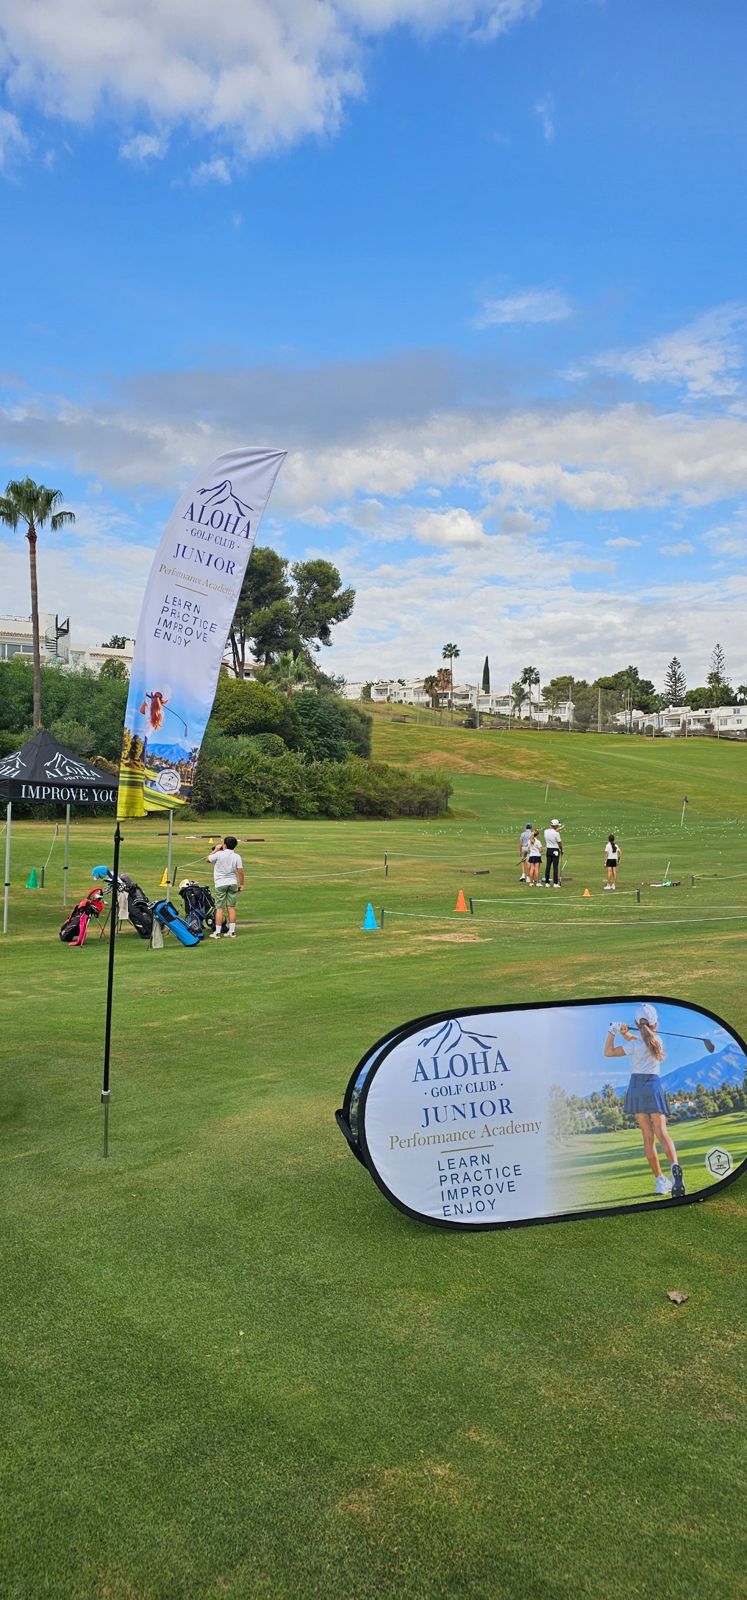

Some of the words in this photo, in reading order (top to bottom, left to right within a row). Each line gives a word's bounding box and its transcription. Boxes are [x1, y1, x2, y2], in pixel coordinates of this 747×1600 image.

[182, 502, 252, 539] ALOHA
[190, 528, 214, 541] GOLF
[215, 536, 235, 550] CLUB
[173, 543, 235, 575] JUNIOR
[164, 594, 200, 614] LEARN
[157, 617, 208, 642] IMPROVE
[161, 607, 218, 632] PRACTICE
[154, 629, 190, 647] ENJOY
[21, 785, 88, 801] IMPROVE
[412, 1049, 510, 1082] ALOHA
[430, 1084, 462, 1097] GOLF
[465, 1080, 496, 1093] CLUB
[421, 1098, 512, 1127] JUNIOR
[389, 1128, 475, 1150] Performance
[480, 1120, 542, 1138] Academy
[438, 1154, 491, 1171] LEARN
[440, 1165, 522, 1186] PRACTICE
[441, 1180, 516, 1202] IMPROVE
[443, 1199, 496, 1216] ENJOY
